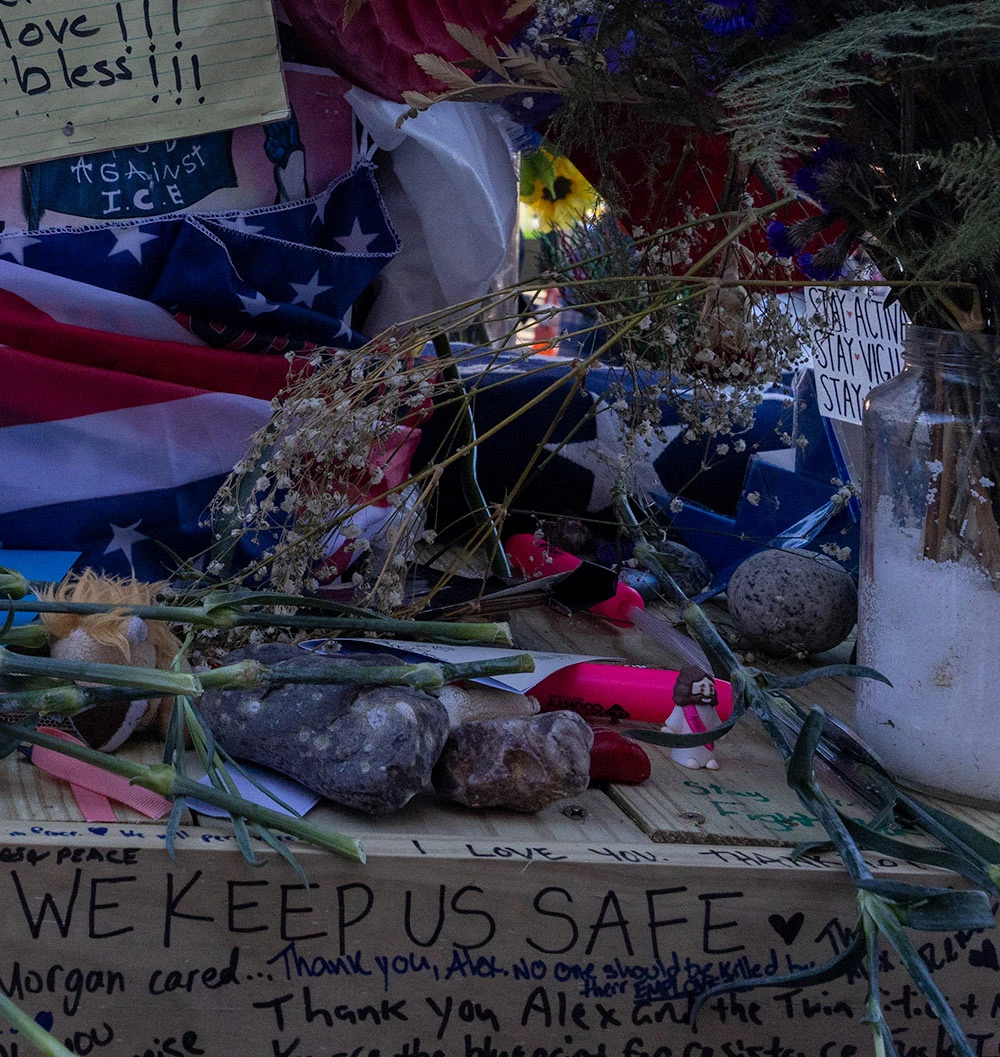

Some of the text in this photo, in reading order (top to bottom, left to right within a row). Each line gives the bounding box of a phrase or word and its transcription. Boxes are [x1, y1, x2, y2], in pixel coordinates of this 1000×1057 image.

[11, 48, 132, 95] bless
[808, 287, 848, 334] STAY
[814, 329, 855, 376] STAY
[819, 374, 862, 421] STAY
[56, 847, 142, 865] PEACE
[411, 839, 427, 855] I
[465, 843, 569, 861] LOVE
[10, 868, 137, 940] WE
[163, 870, 374, 955] KEEP
[404, 884, 497, 950] US
[525, 885, 746, 960] SAFE
[267, 941, 372, 980] Thank
[252, 986, 408, 1032] Thank
[521, 986, 622, 1030] Alex
[711, 993, 762, 1025] the
